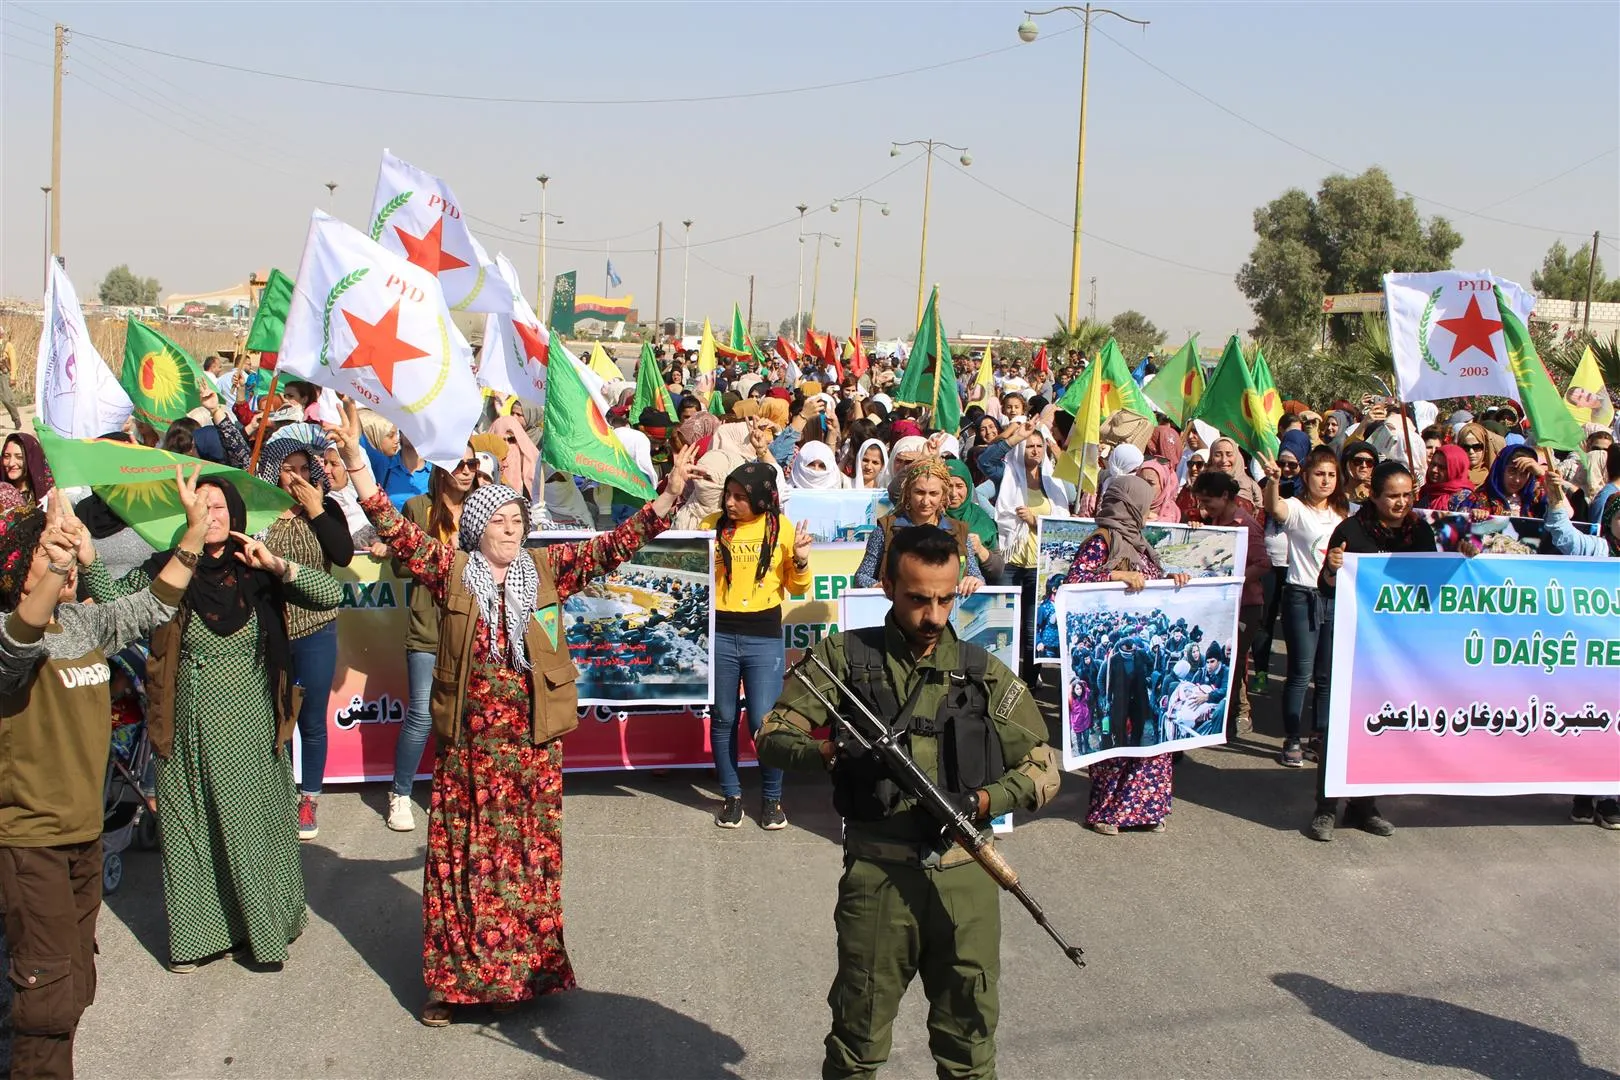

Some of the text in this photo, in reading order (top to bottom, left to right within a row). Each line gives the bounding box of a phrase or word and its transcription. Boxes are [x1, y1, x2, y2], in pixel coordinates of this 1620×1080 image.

[427, 194, 460, 219] PYD
[386, 274, 424, 302] PYD
[1458, 280, 1491, 291] PYD
[1459, 366, 1489, 377] 2003
[351, 379, 381, 404] 2003
[340, 582, 396, 608] AXA
[1375, 586, 1431, 612] AXA
[1440, 579, 1537, 614] BAKÛR
[1547, 580, 1565, 614] Û
[1465, 630, 1620, 673] Û DAÎŞÊ RE
[337, 696, 404, 727] داعش
[1366, 703, 1429, 734] داعش
[1434, 708, 1447, 734] و
[1452, 697, 1537, 734] أردوغان
[1544, 703, 1611, 736] مقبرة
